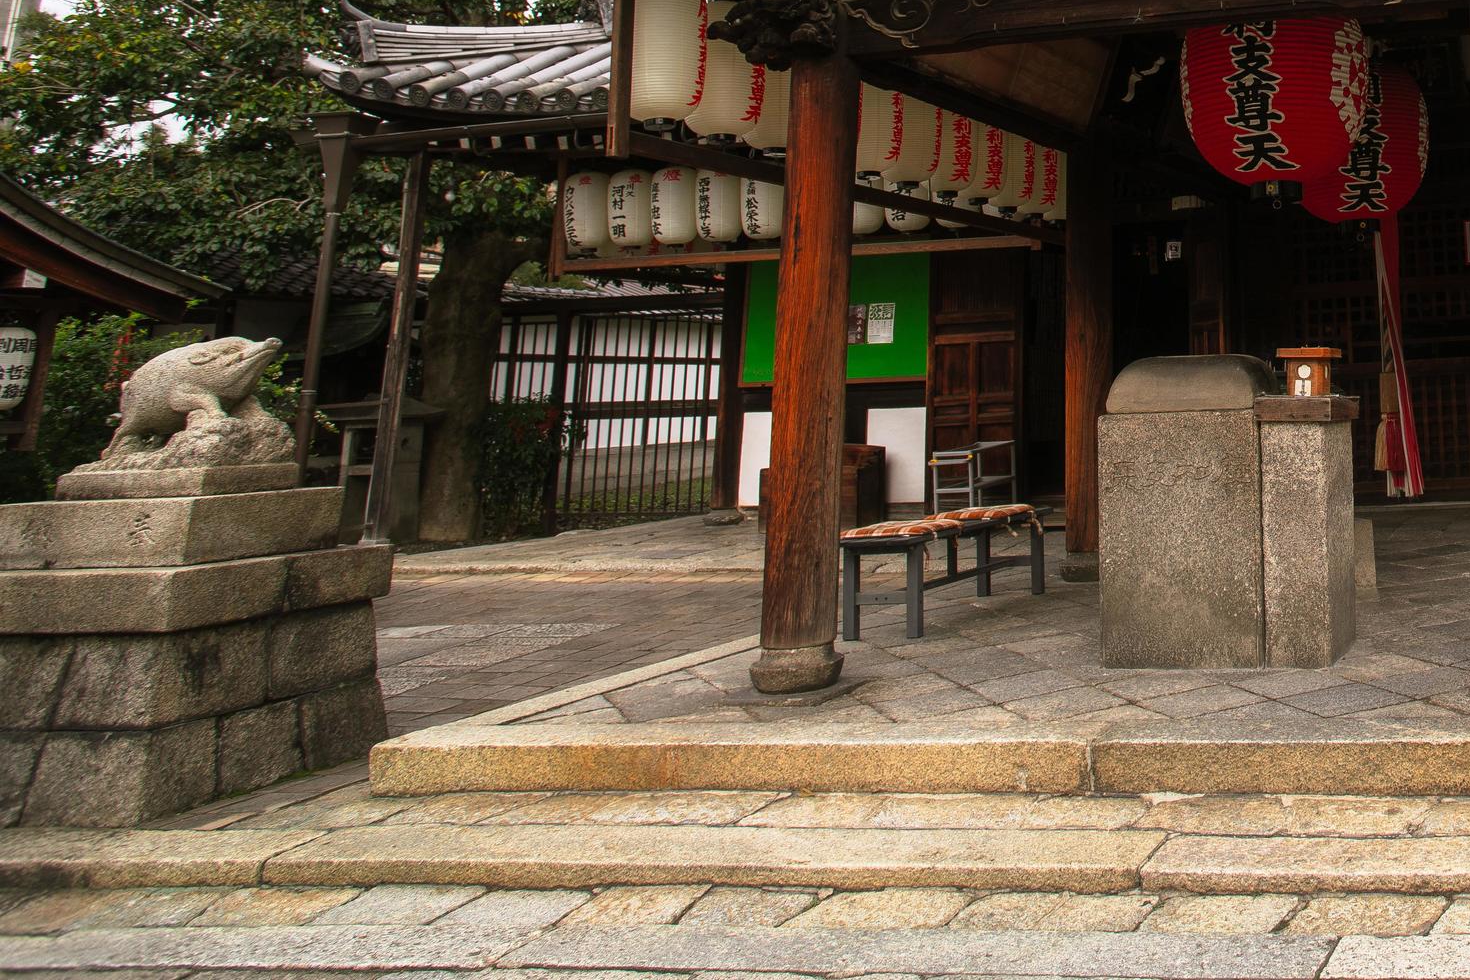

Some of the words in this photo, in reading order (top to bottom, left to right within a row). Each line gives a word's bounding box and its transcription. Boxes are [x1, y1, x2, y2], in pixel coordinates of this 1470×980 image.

[949, 112, 972, 182] 利支尊天
[983, 126, 1004, 190] 利支尊天
[611, 185, 627, 238] 河村一明
